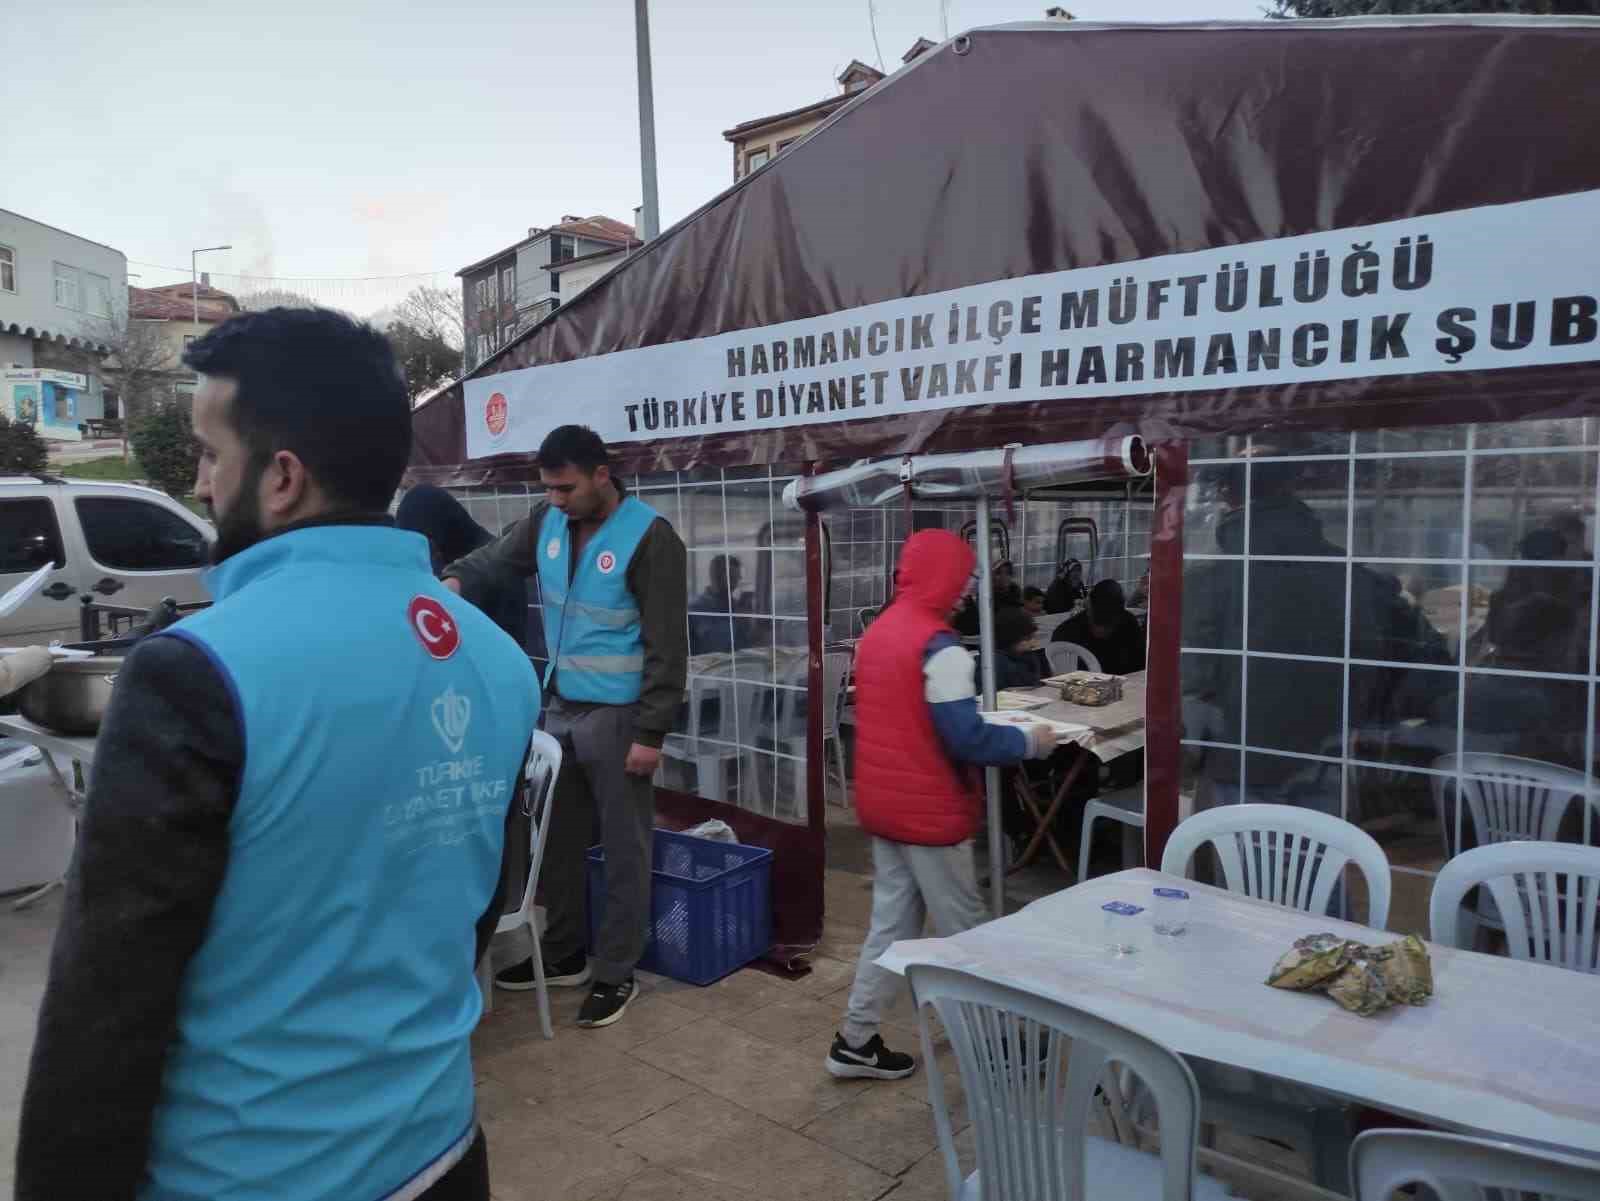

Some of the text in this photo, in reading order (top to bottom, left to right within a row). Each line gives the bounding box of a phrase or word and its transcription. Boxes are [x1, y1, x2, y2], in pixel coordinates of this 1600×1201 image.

[624, 295, 1598, 433] TÜRKİYE DİYANET VAKFI HARMANCIK ŞUB
[727, 234, 1434, 378] HARMANCIK İLÇE MÜFTÜLÜĞÜ
